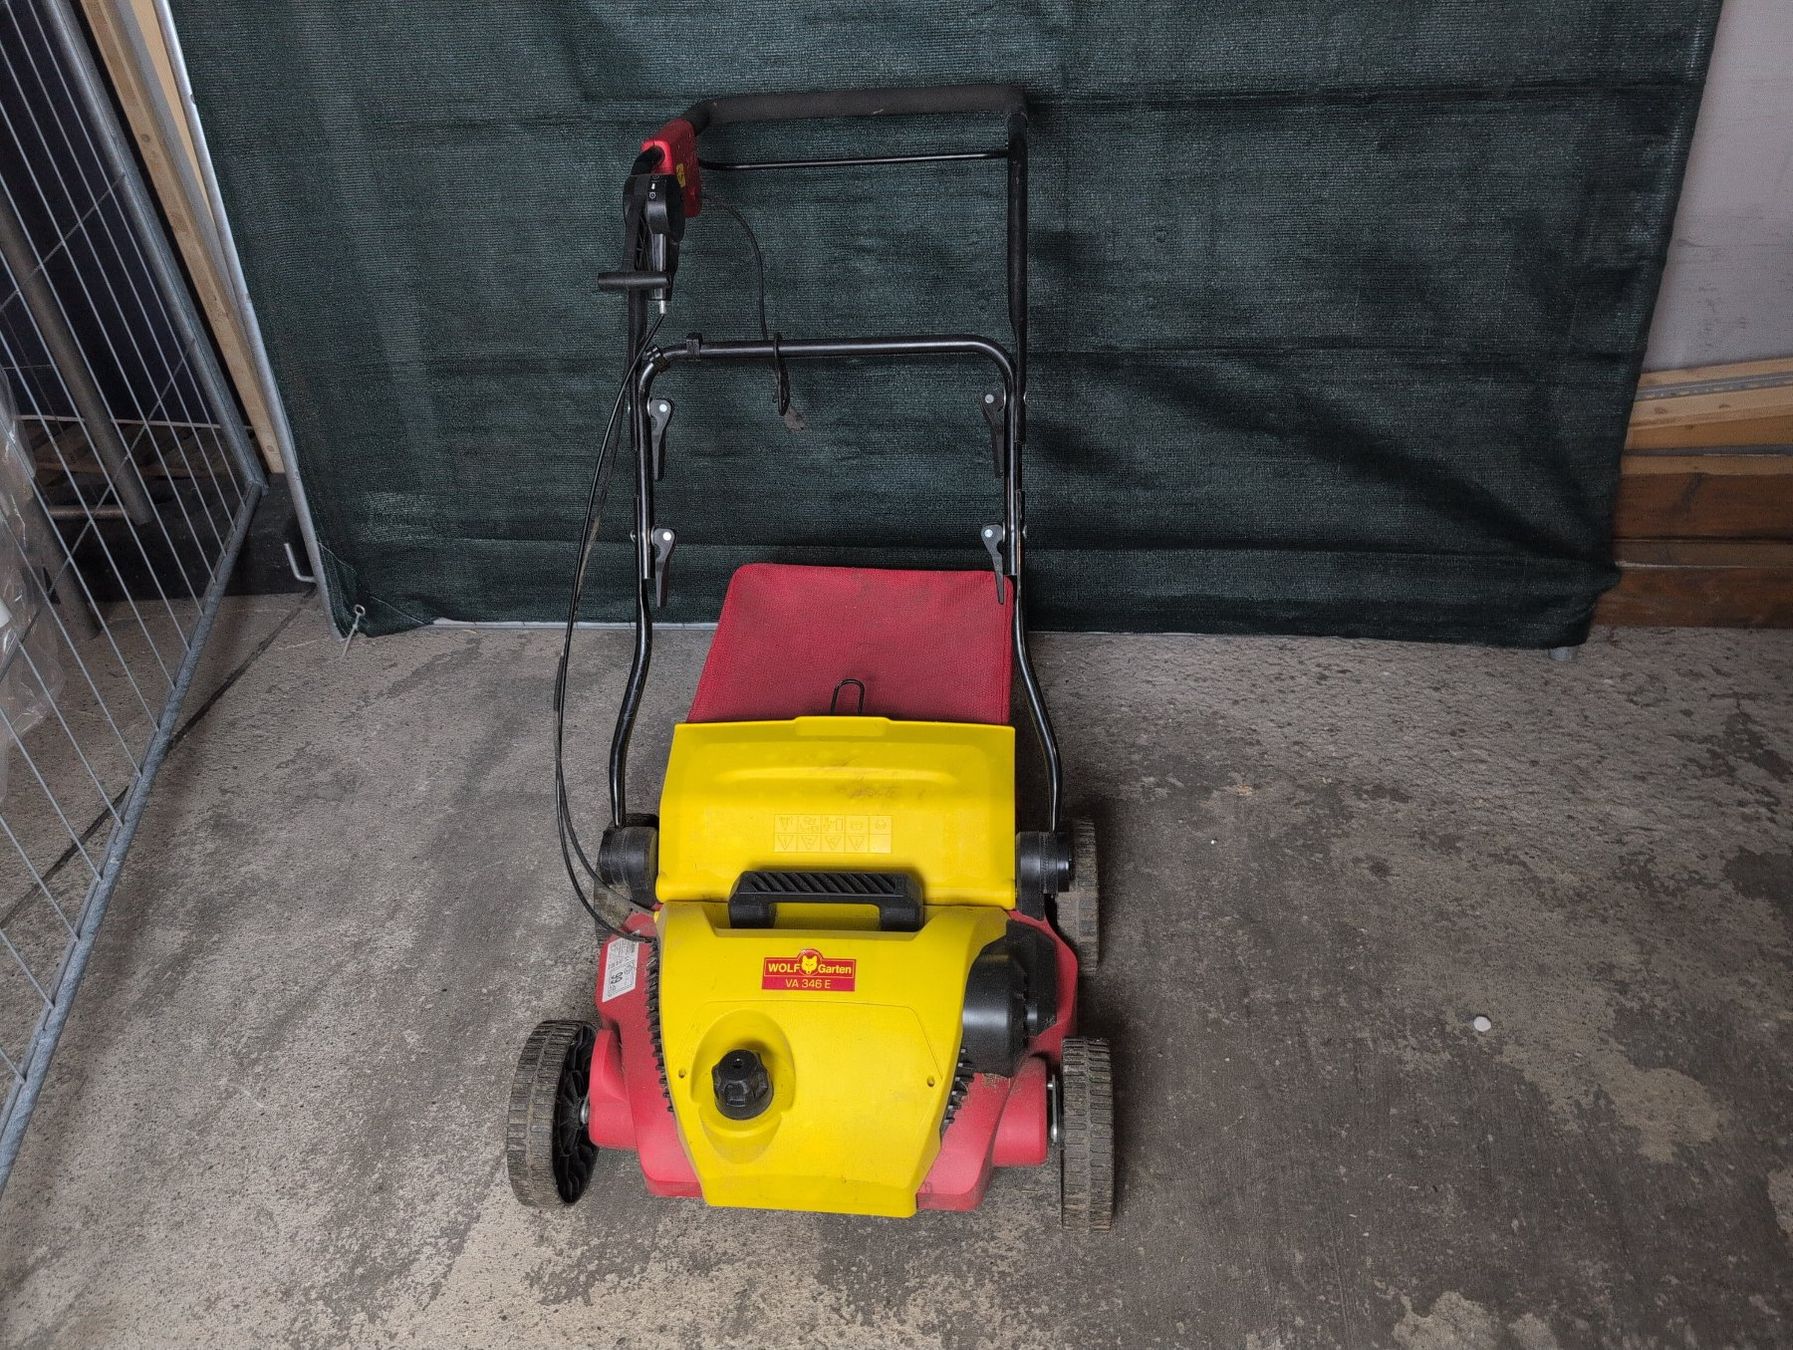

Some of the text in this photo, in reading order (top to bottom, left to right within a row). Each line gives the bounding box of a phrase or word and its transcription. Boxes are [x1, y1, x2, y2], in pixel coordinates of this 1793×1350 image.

[768, 963, 852, 974] WOLF Garten
[785, 978, 831, 989] VA 346 E
